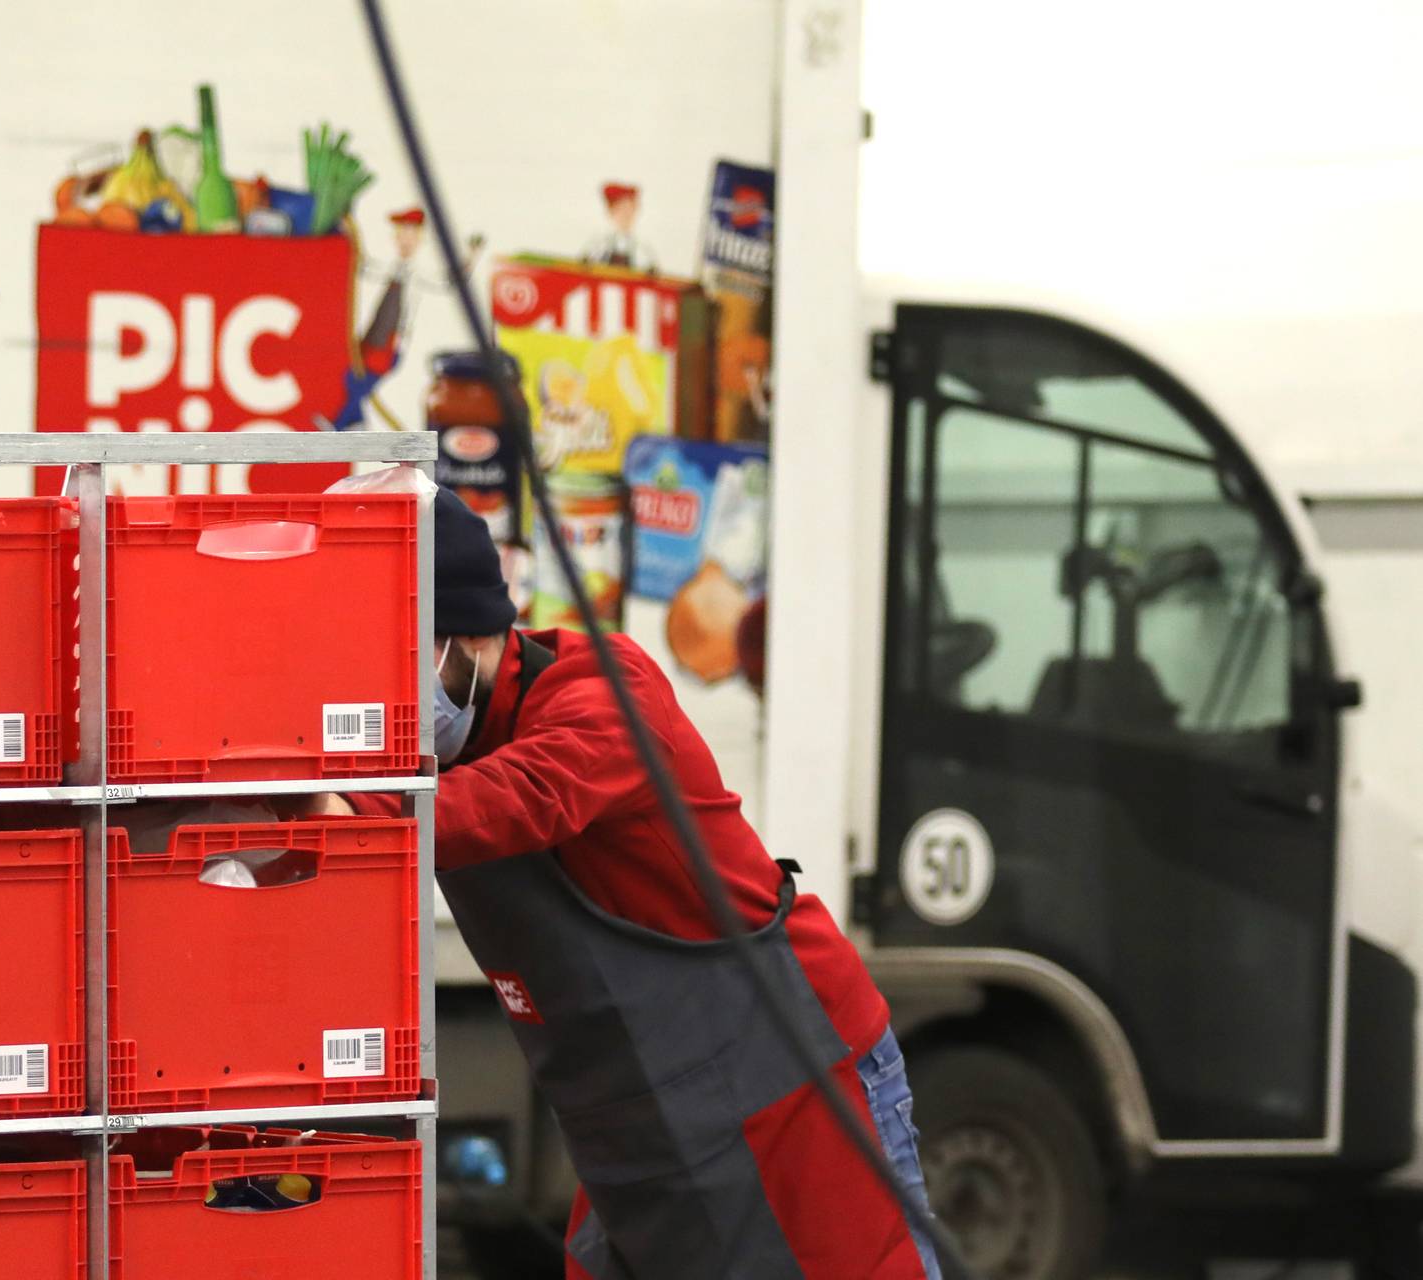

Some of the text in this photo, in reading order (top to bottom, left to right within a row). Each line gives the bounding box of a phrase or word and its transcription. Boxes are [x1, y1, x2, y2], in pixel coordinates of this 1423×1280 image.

[85, 291, 302, 414] PIC
[107, 788, 120, 798] 32
[19, 842, 31, 858] C
[923, 837, 970, 898] 50
[108, 1117, 121, 1127] 29
[21, 1174, 33, 1190] C
